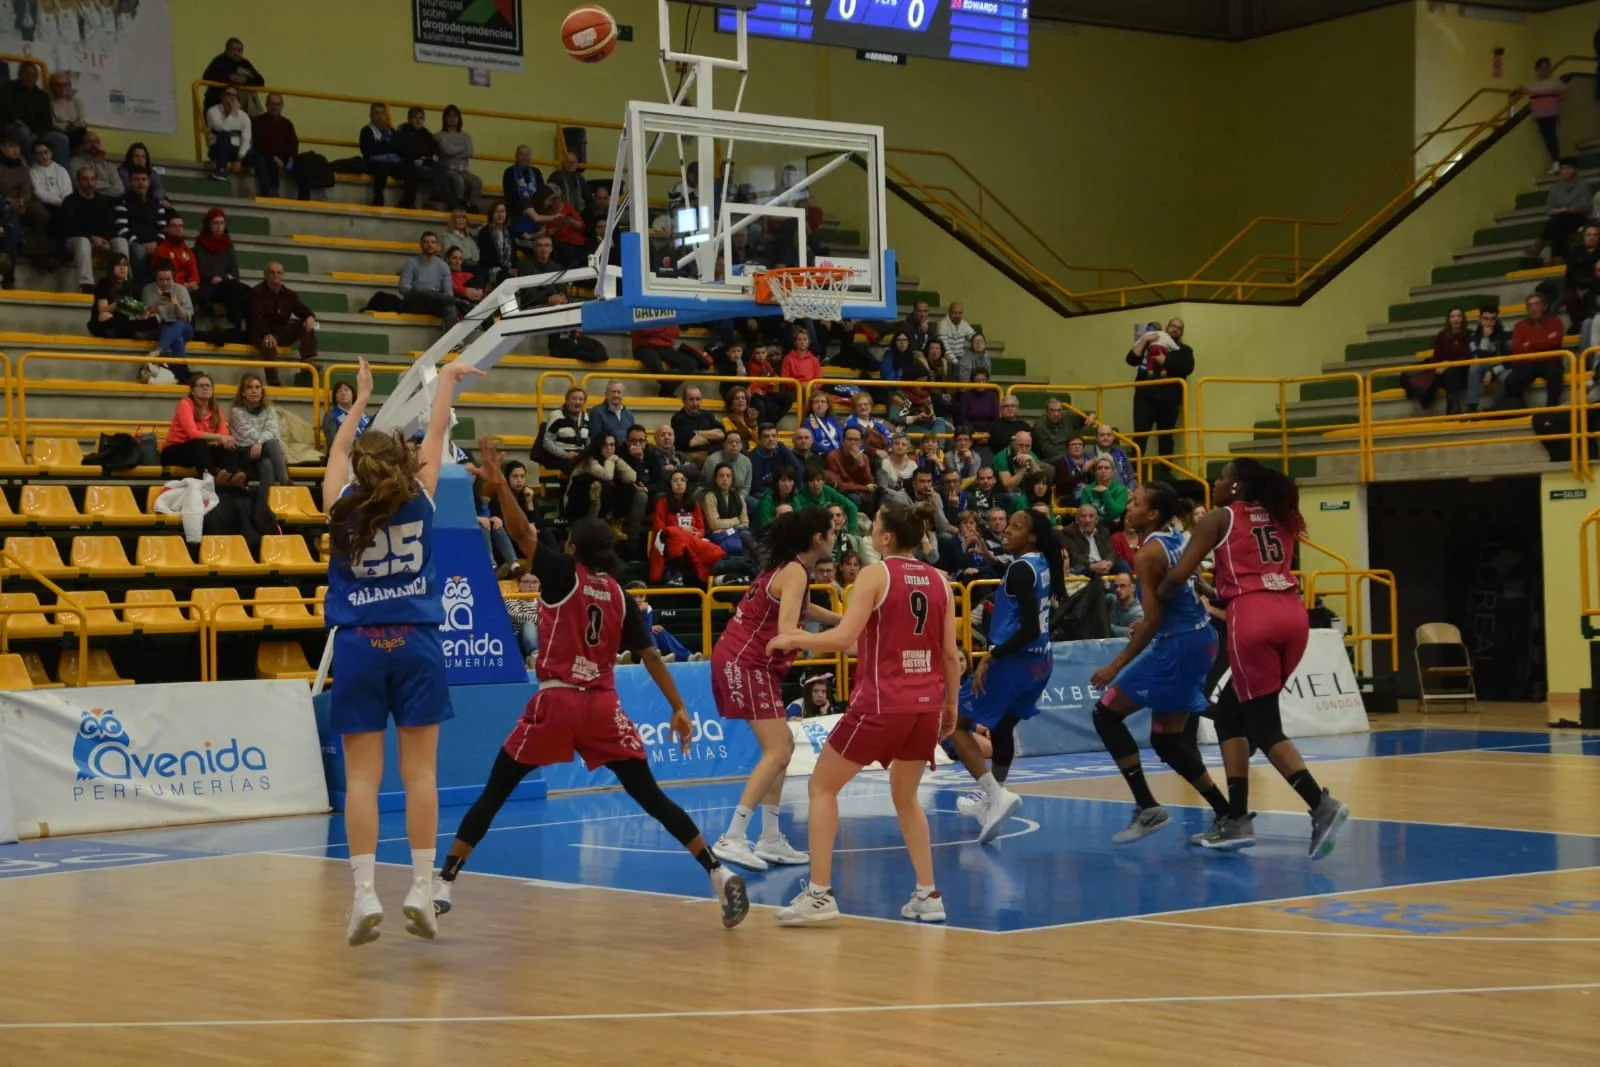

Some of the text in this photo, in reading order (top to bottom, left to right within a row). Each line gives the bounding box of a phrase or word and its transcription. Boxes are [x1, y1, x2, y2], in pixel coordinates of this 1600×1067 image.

[422, 7, 447, 19] sobre
[838, 0, 857, 19] 0
[907, 0, 925, 29] 0
[963, 0, 999, 15] EDWARDS
[422, 19, 513, 40] drogodependencias
[350, 520, 424, 579] 25
[1250, 524, 1285, 564] 15
[585, 603, 604, 647] 0
[909, 590, 928, 636] 9
[371, 636, 406, 653] viajes
[442, 632, 503, 656] enida
[445, 656, 504, 668] UMERÍAS
[1282, 672, 1356, 699] MEL
[1316, 698, 1361, 711] LONDON
[94, 738, 267, 780] avenida
[73, 776, 271, 801] PERFUMERÍAS
